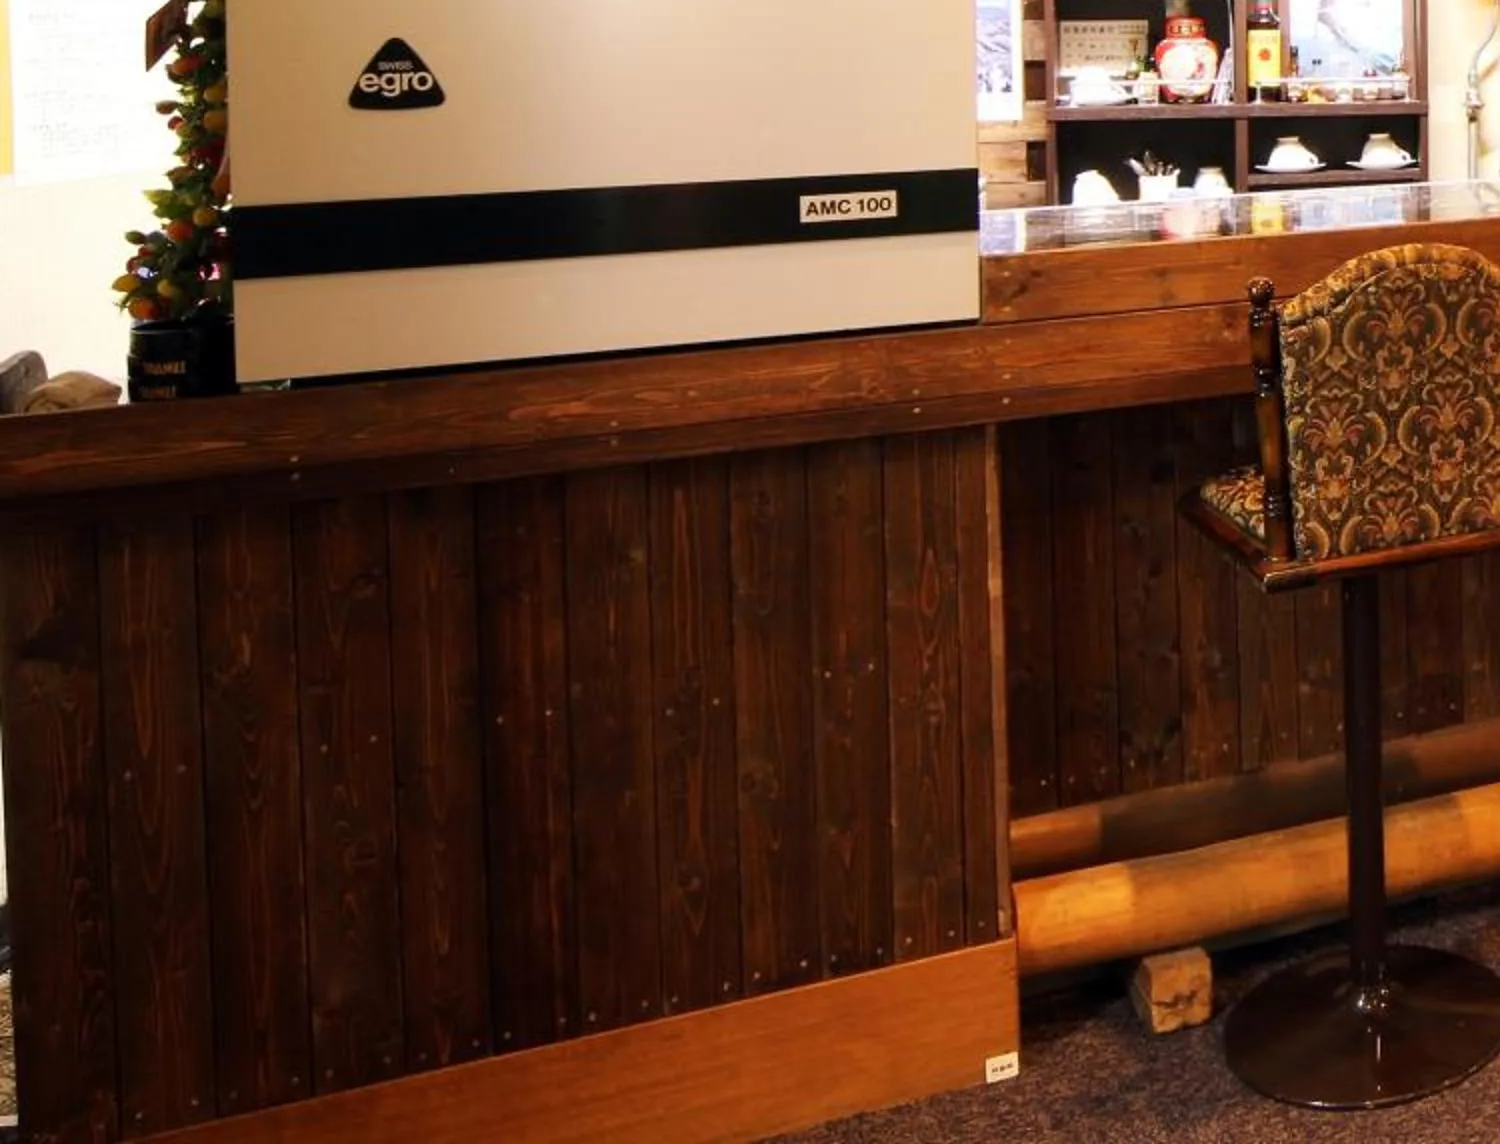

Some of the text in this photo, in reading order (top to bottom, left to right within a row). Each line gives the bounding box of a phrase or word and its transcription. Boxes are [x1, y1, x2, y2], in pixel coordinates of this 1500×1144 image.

[359, 71, 434, 97] egro
[806, 197, 892, 217] AMC 100
